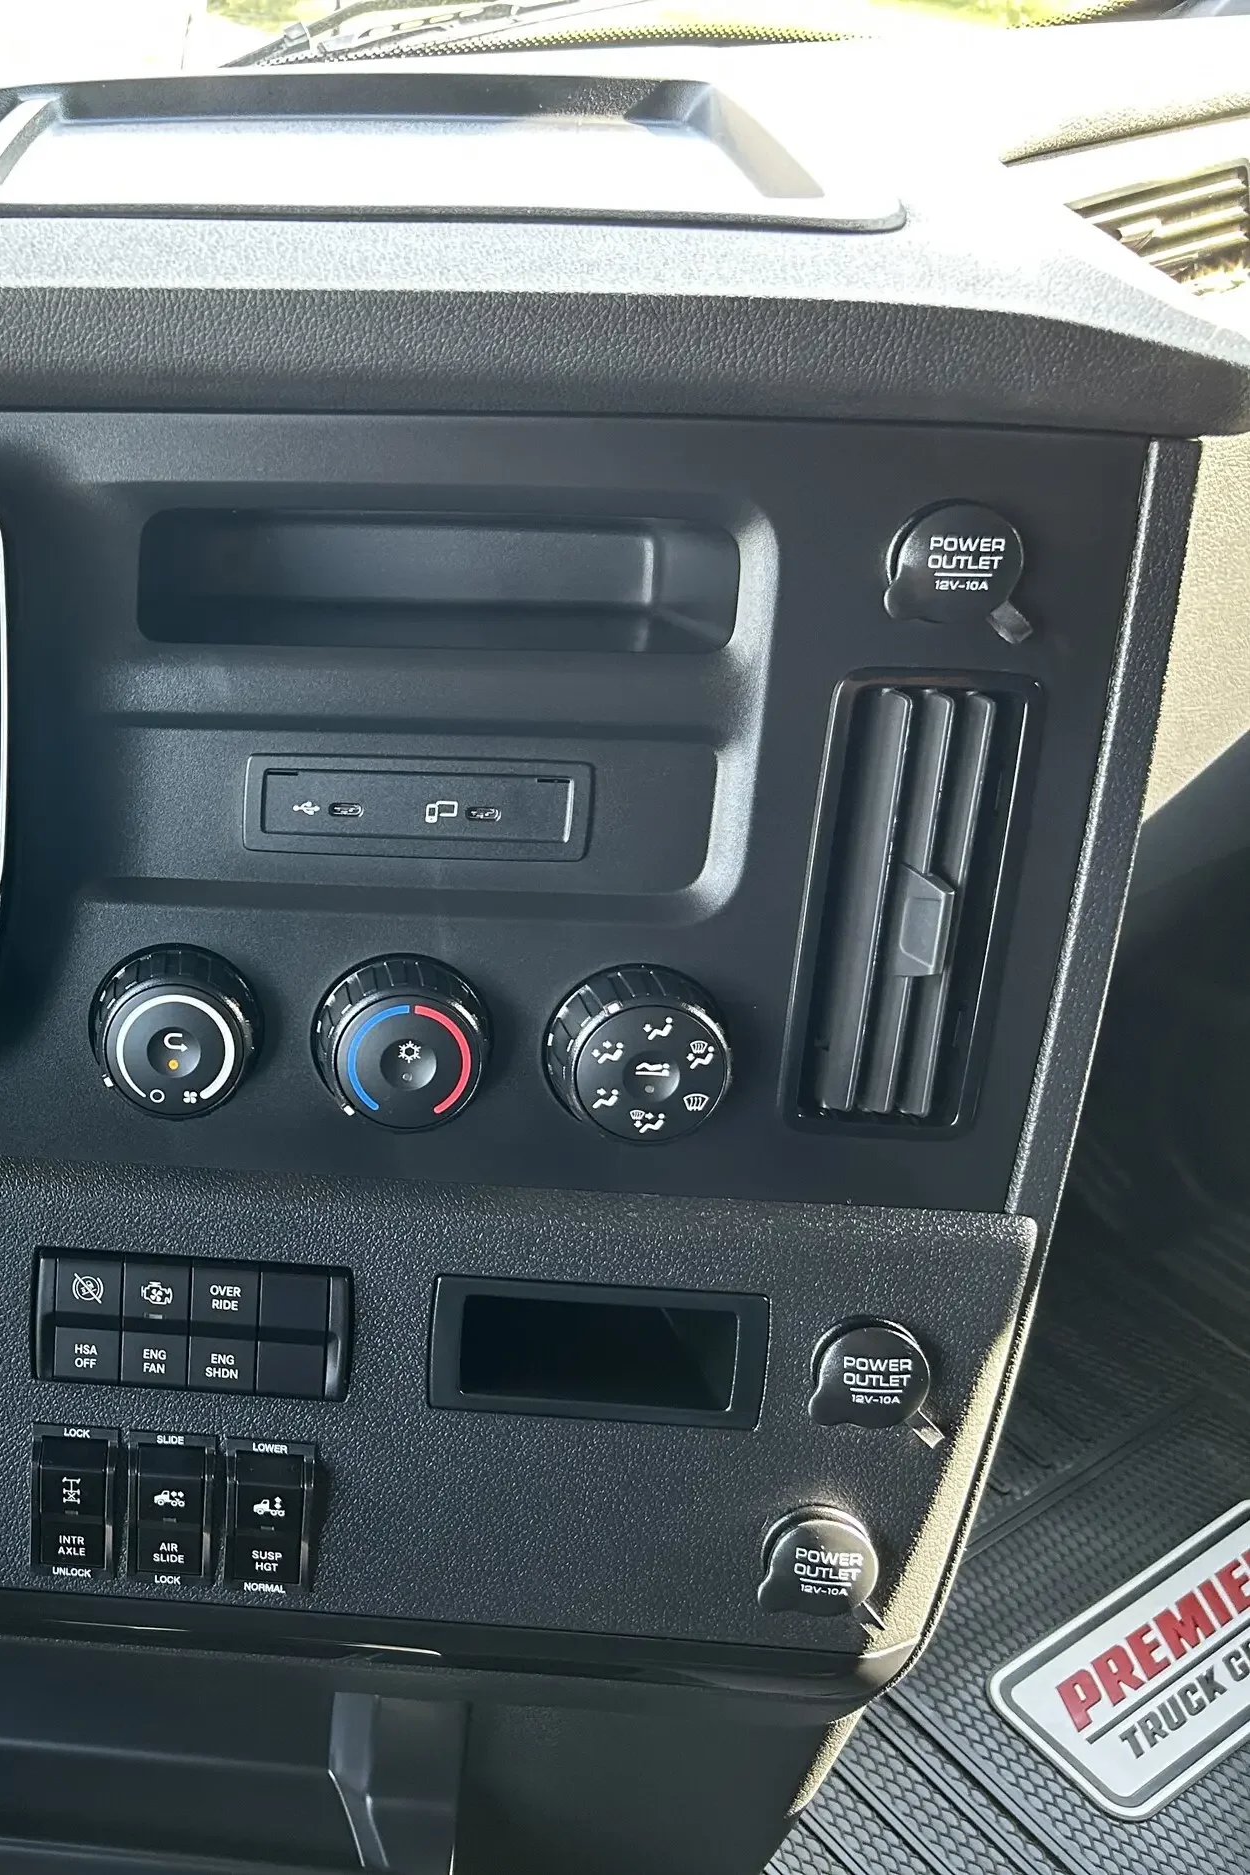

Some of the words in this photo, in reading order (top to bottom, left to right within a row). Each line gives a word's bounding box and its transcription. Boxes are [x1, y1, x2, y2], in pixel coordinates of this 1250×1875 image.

[929, 536, 1006, 552] POWER
[927, 554, 1003, 570] OUTLET
[934, 579, 989, 591] 12V-10A
[209, 1284, 241, 1298] OVER
[211, 1298, 239, 1312] RIDE
[74, 1343, 98, 1355] HSA
[142, 1348, 167, 1361] ENG
[74, 1357, 97, 1369] OFF
[210, 1353, 235, 1366] ENG
[843, 1356, 913, 1372] POWER
[142, 1361, 166, 1374] FAN
[205, 1366, 239, 1380] SHDN
[843, 1372, 911, 1387] OUTLET
[851, 1394, 901, 1405] 12V-10A
[63, 1427, 91, 1439] LOCK
[156, 1434, 185, 1445] SLIDE
[252, 1442, 288, 1454] LOWER
[58, 1534, 85, 1546] INTR
[57, 1545, 86, 1557] AXLE
[159, 1542, 178, 1553] AIR
[152, 1552, 185, 1564] SLIDE
[251, 1550, 283, 1562] SUSP
[795, 1547, 864, 1567] POWER
[52, 1566, 92, 1578] UNLOCK
[255, 1561, 279, 1573] HGT
[793, 1562, 862, 1581] OUTLET
[154, 1574, 181, 1585] LOCK
[243, 1581, 286, 1594] NORMAL
[800, 1583, 849, 1597] 12V-10A
[1055, 1548, 1250, 1733] PREMIE
[1117, 1663, 1229, 1760] TRUCK
